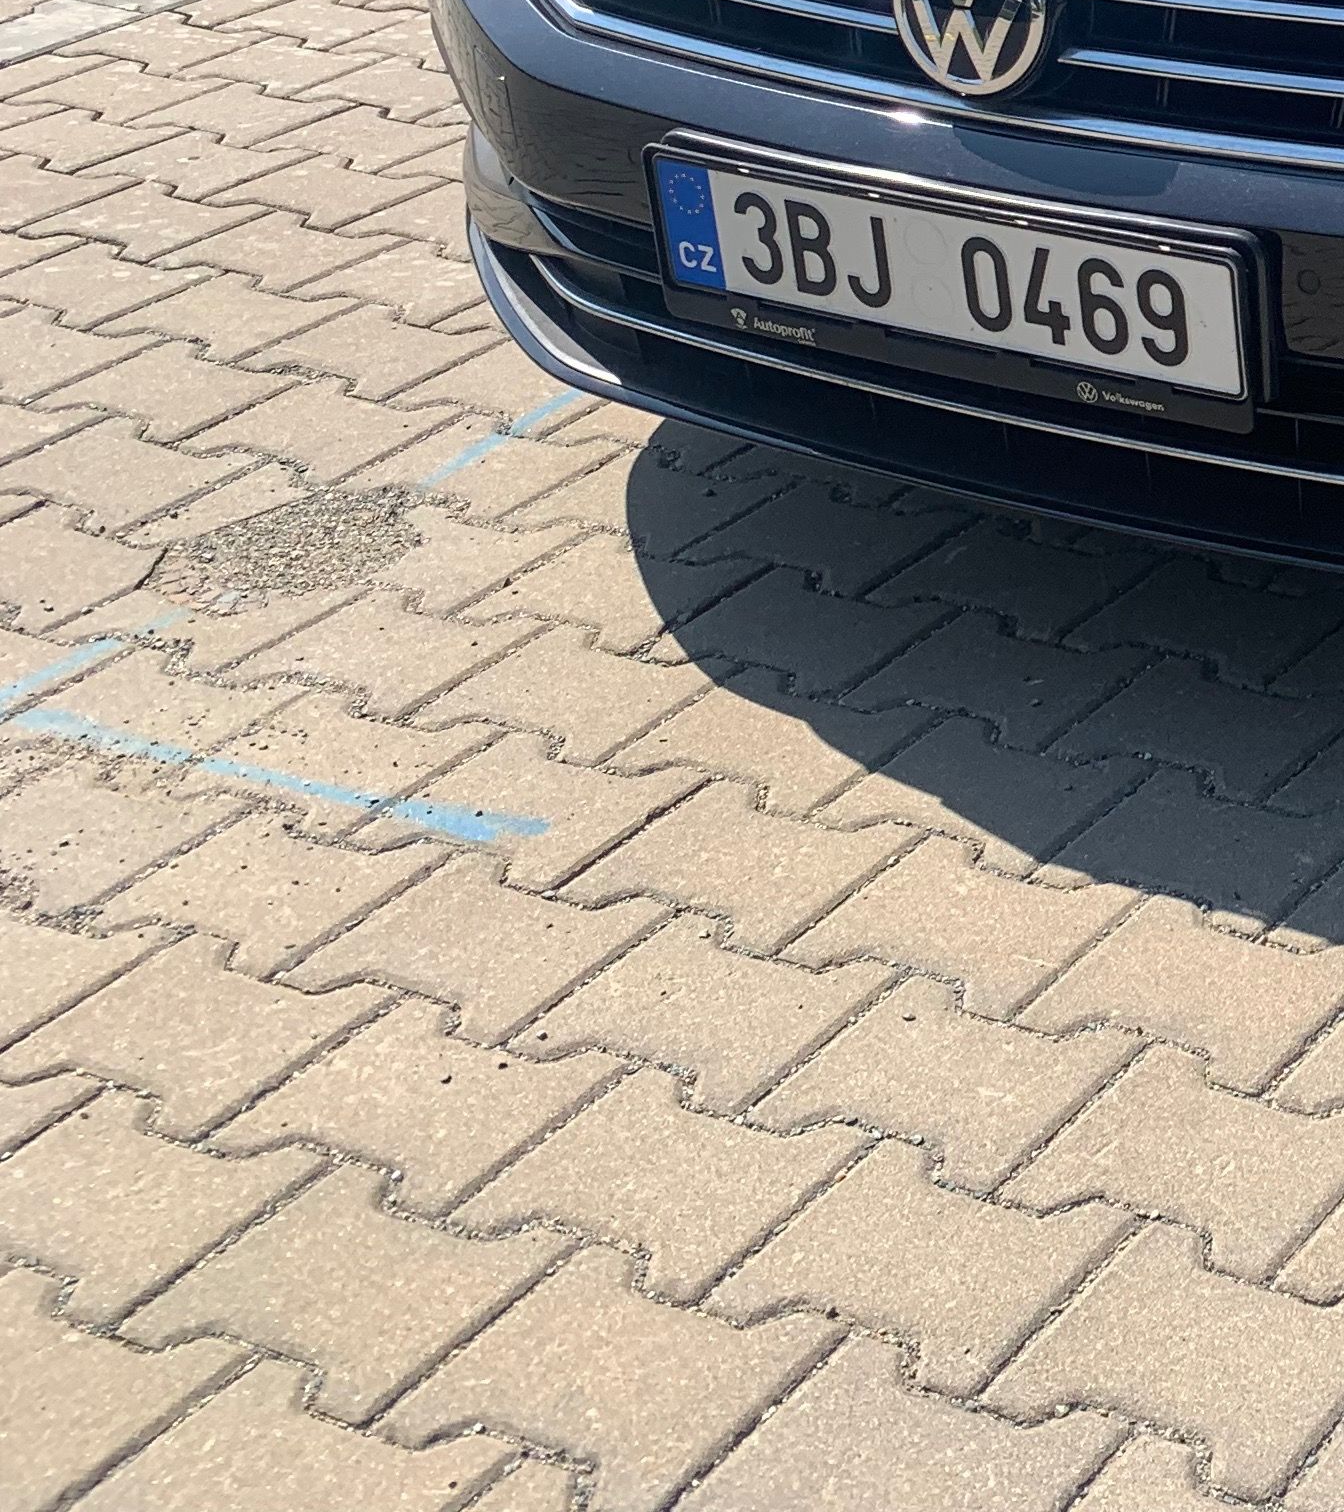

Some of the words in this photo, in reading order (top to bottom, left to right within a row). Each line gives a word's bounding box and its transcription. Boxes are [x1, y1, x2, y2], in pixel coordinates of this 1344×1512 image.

[678, 238, 717, 274] CZ
[733, 191, 892, 309] 3BJ
[961, 235, 1190, 368] 0469
[1101, 390, 1165, 412] Volkswagen
